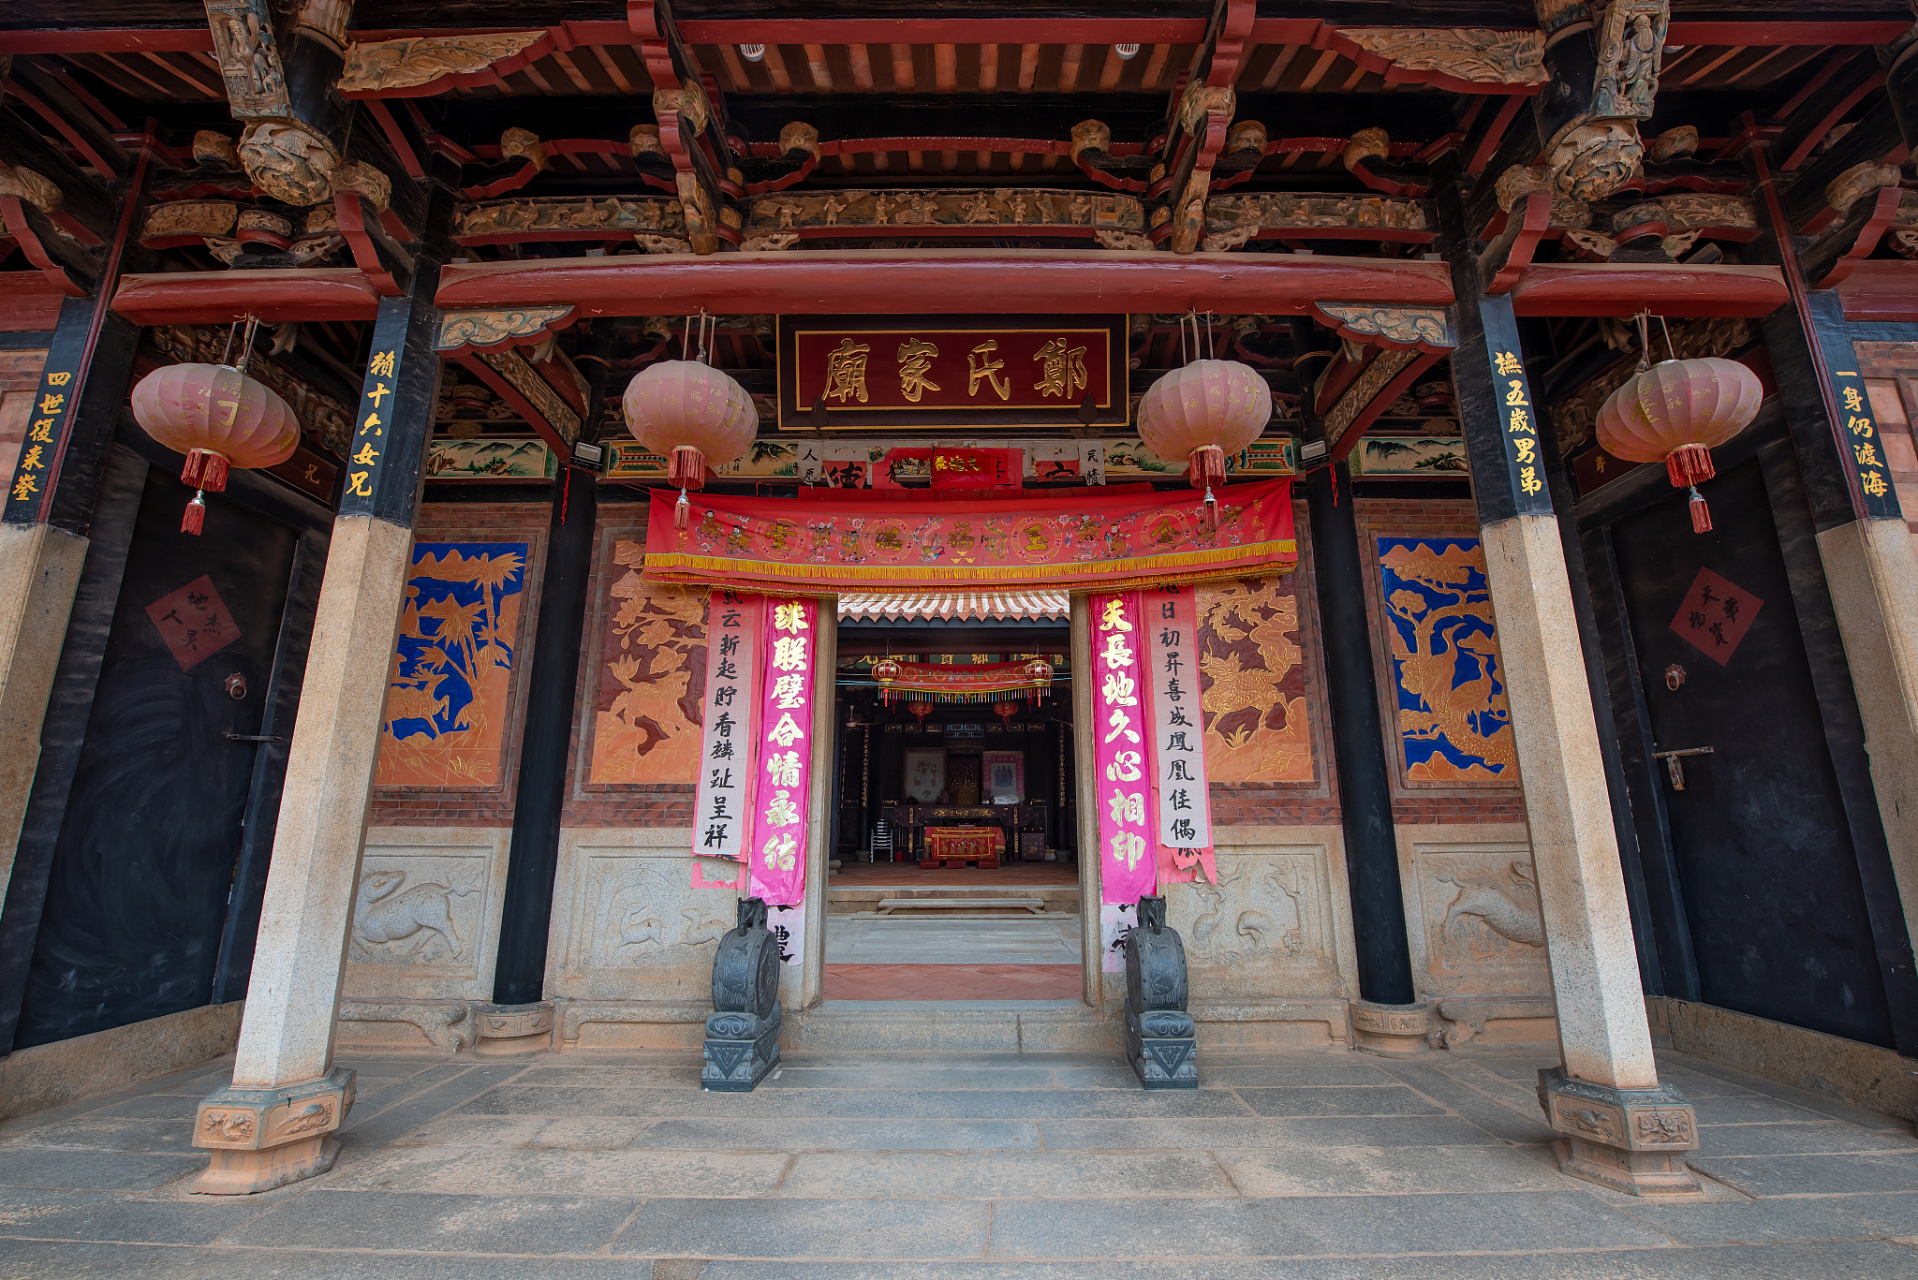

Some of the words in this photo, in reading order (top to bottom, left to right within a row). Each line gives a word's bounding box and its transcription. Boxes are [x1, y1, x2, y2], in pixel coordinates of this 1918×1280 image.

[820, 337, 1090, 404] 鄭氏家廟
[1835, 370, 1889, 498] 一身仍渡海
